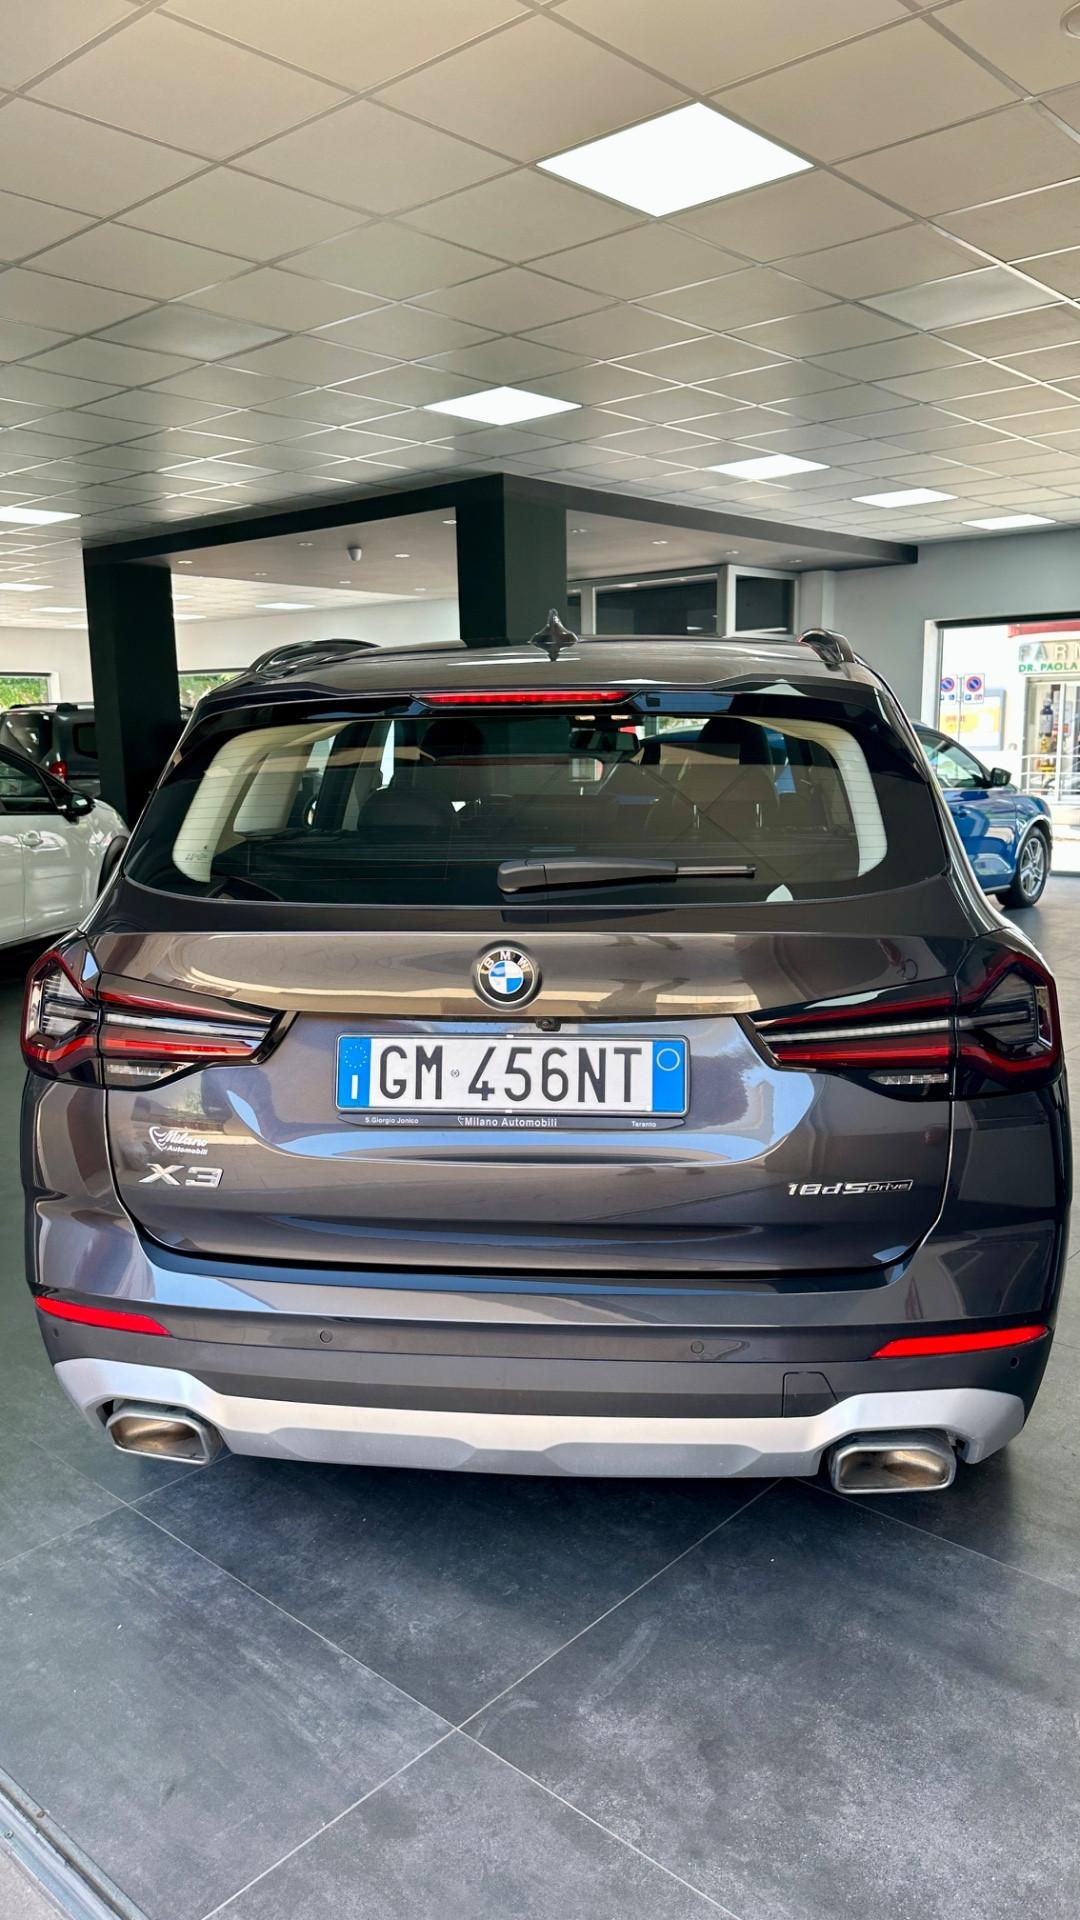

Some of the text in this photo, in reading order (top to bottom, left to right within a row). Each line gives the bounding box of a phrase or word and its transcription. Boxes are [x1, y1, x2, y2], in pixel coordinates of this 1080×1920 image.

[1040, 662, 1078, 671] PAOLA
[483, 950, 532, 972] BMW
[379, 1044, 643, 1103] GM 456NT
[464, 1117, 557, 1127] Milano Automobili
[138, 1163, 224, 1188] X3
